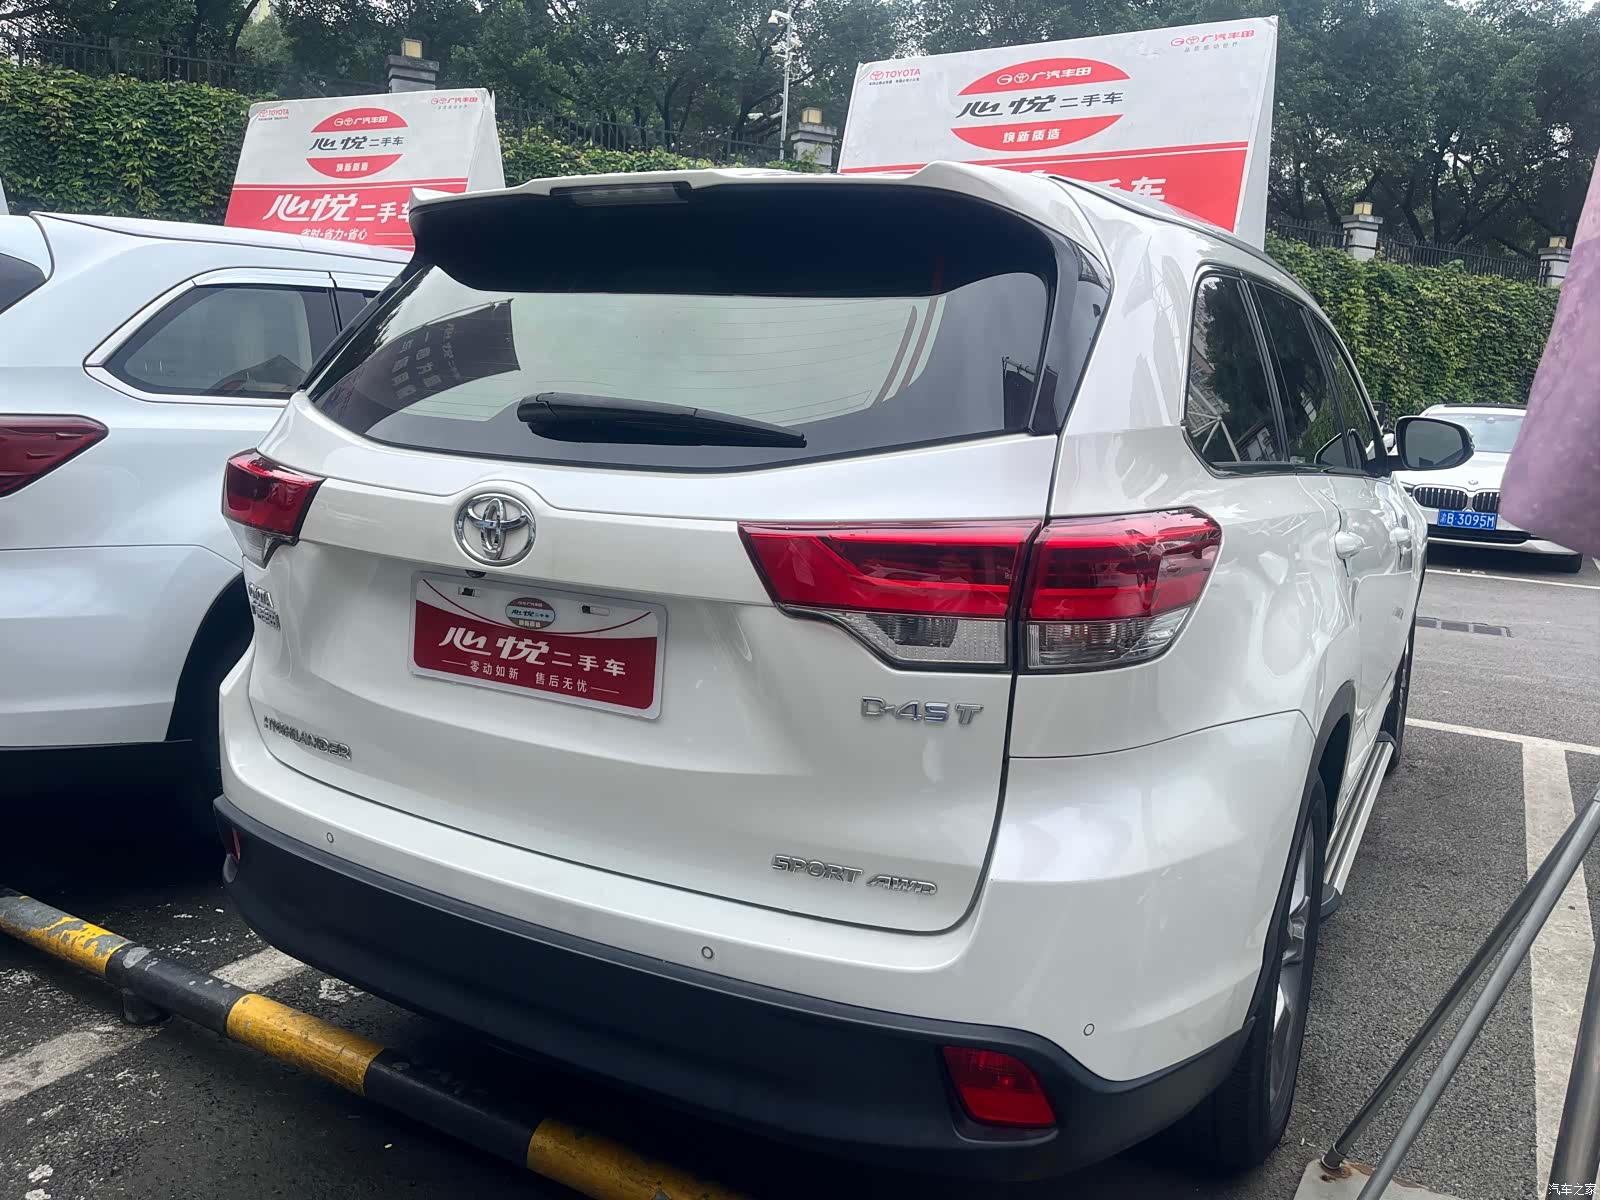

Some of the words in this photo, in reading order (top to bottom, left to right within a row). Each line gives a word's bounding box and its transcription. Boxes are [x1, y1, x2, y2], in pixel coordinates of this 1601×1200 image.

[1201, 30, 1255, 43] 广汽丰田
[885, 69, 921, 78] TOYOTA
[1030, 66, 1092, 82] 广汽丰田
[955, 91, 1124, 118] 心悦二手车
[268, 109, 289, 117] TOYOTA
[353, 115, 388, 125] 广汽丰田
[309, 136, 405, 151] 心悦二手车
[1003, 128, 1062, 144] 焕新质造
[439, 626, 627, 678] 心悦二手车
[470, 660, 519, 680] 零动如新
[535, 671, 588, 693] 售后无忧
[263, 715, 352, 761] HIGHLANDER
[772, 853, 864, 884] SPORT
[866, 874, 938, 896] AWD
